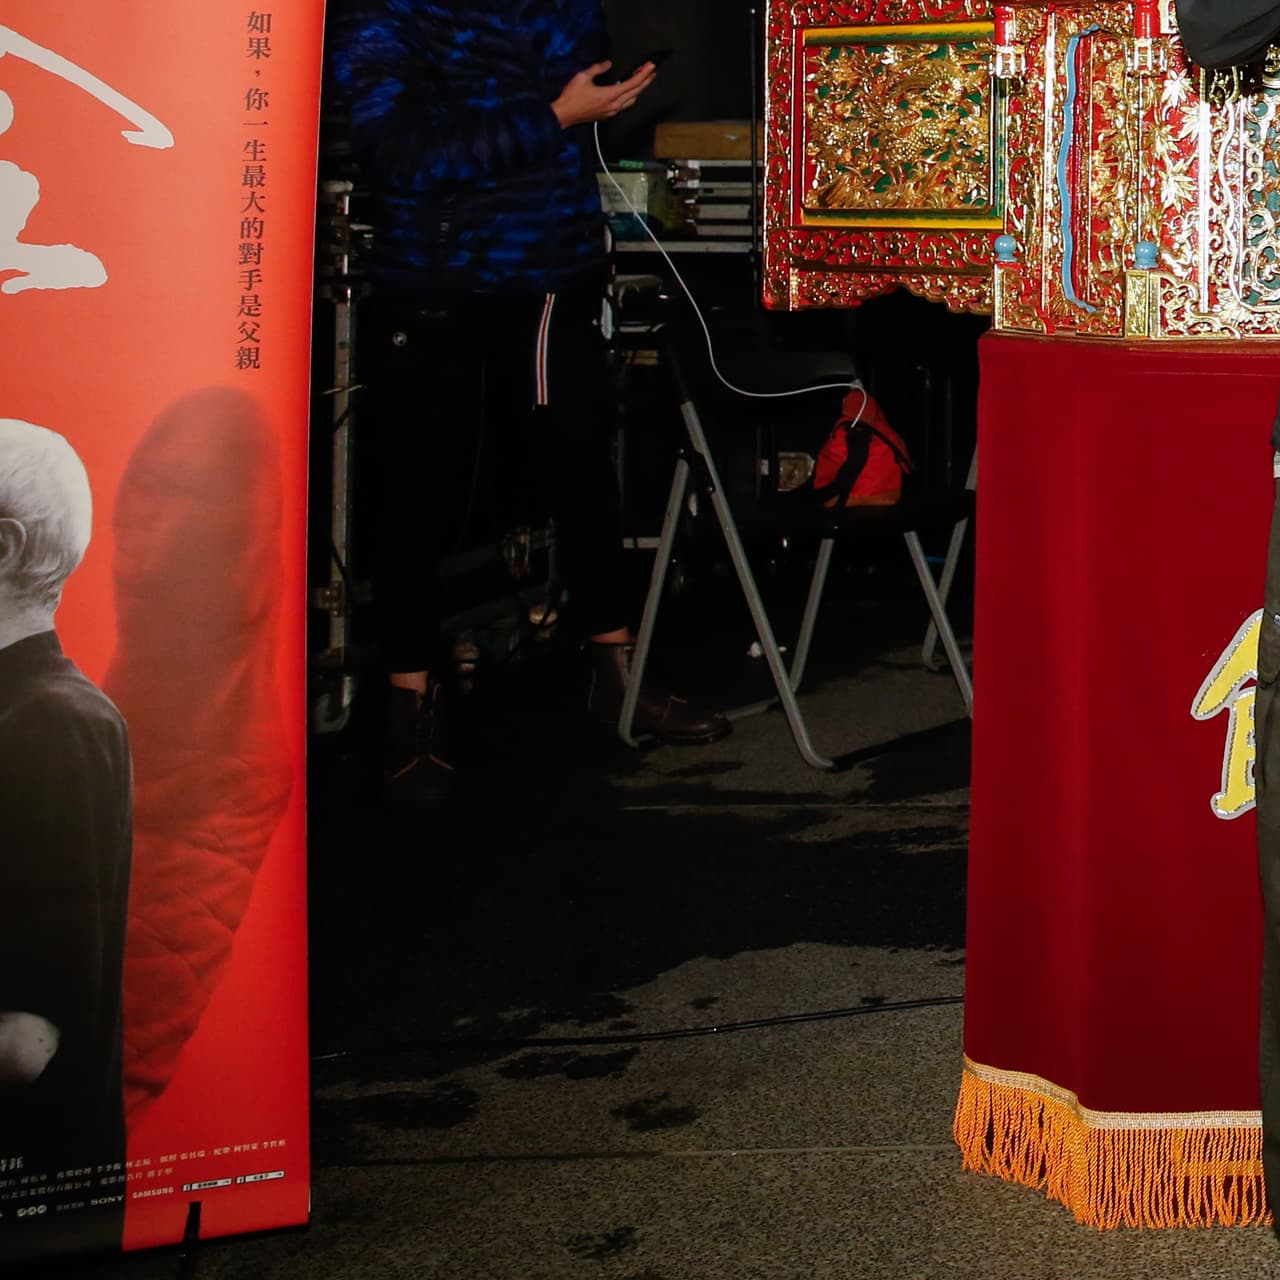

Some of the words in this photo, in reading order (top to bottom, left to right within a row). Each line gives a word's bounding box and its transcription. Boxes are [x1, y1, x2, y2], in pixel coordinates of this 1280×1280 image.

[235, 11, 272, 370] 如果，你一生最大的對手是父親
[90, 1194, 125, 1206] SONY
[132, 1186, 175, 1199] SAMSUNG
